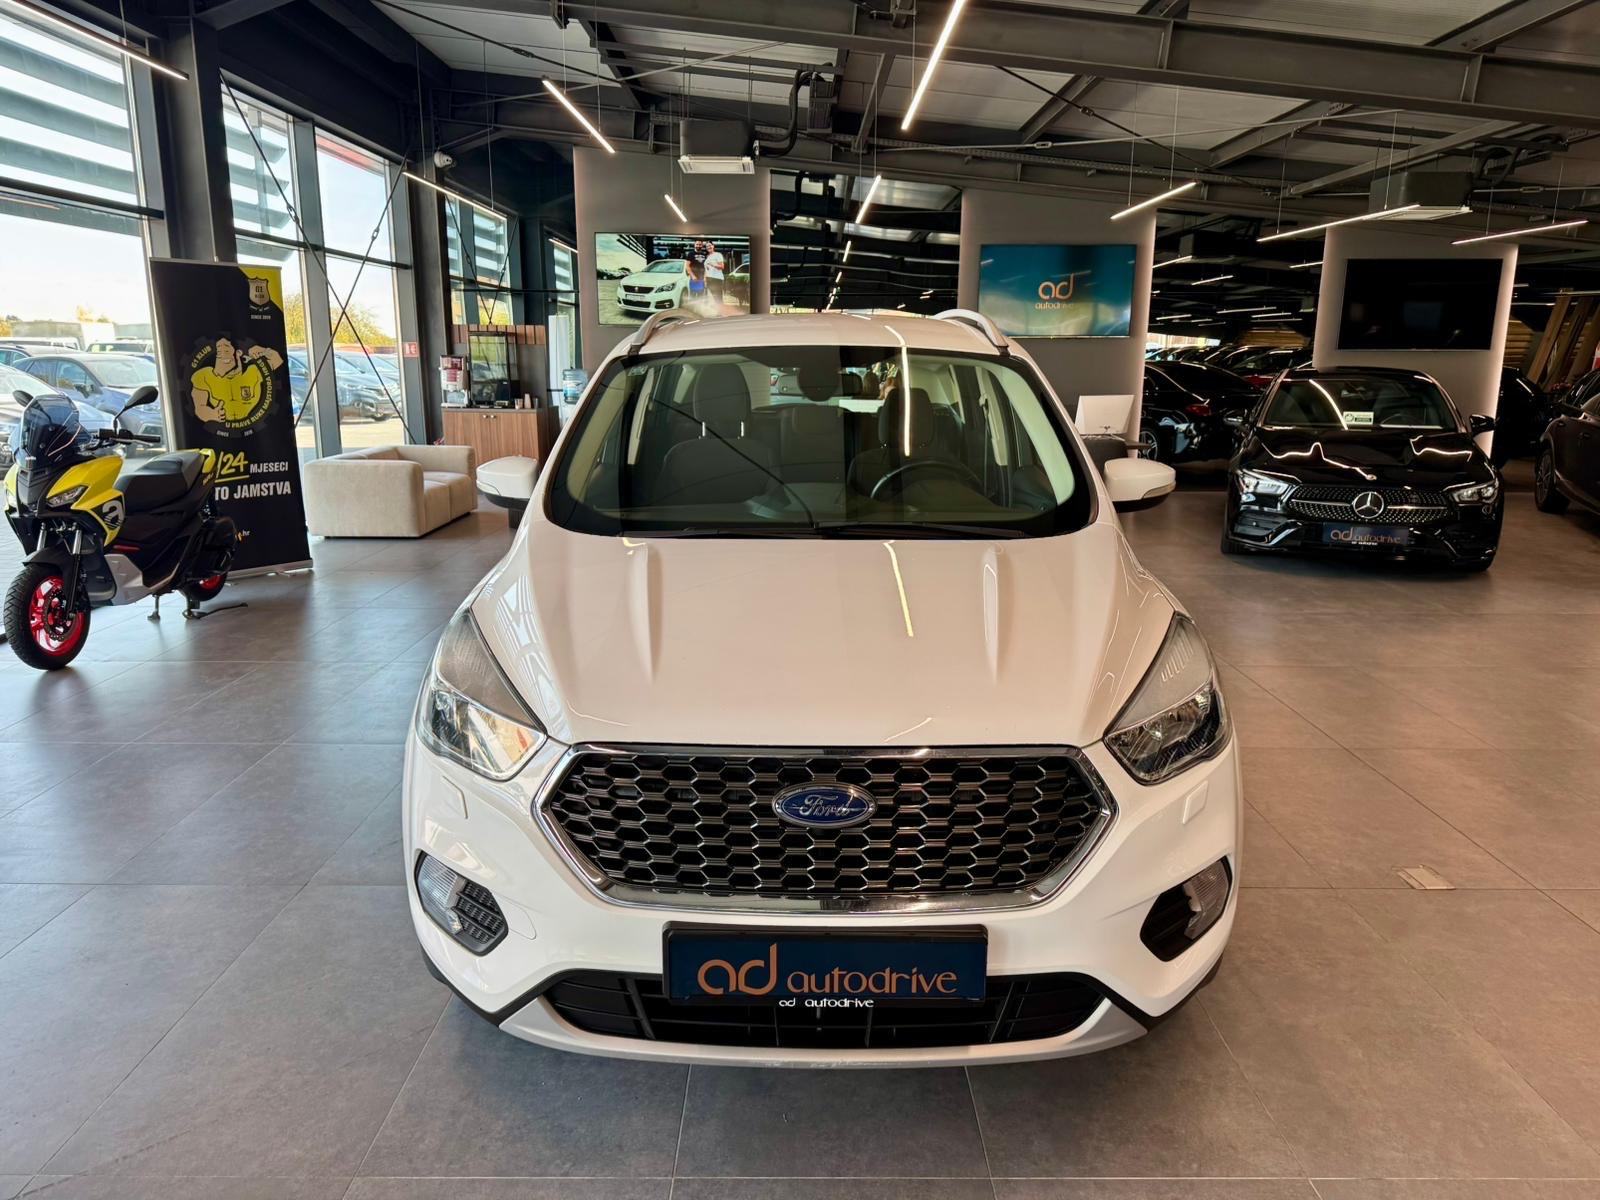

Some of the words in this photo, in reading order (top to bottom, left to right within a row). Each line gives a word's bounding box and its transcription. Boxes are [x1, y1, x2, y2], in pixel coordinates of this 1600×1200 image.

[1038, 272, 1075, 300] ad
[196, 344, 213, 362] KLUB
[231, 419, 252, 429] PRAVE
[250, 409, 266, 423] RUKE
[261, 376, 273, 410] MAJSTORA
[249, 461, 289, 474] MJESECI
[214, 486, 230, 501] TO
[233, 480, 292, 499] JAMSTVA
[1330, 527, 1354, 541] ad
[797, 793, 854, 817] Ford
[696, 942, 778, 996] ad
[786, 965, 959, 995] autodrive
[778, 996, 797, 1008] ad
[804, 996, 875, 1009] autodrive
